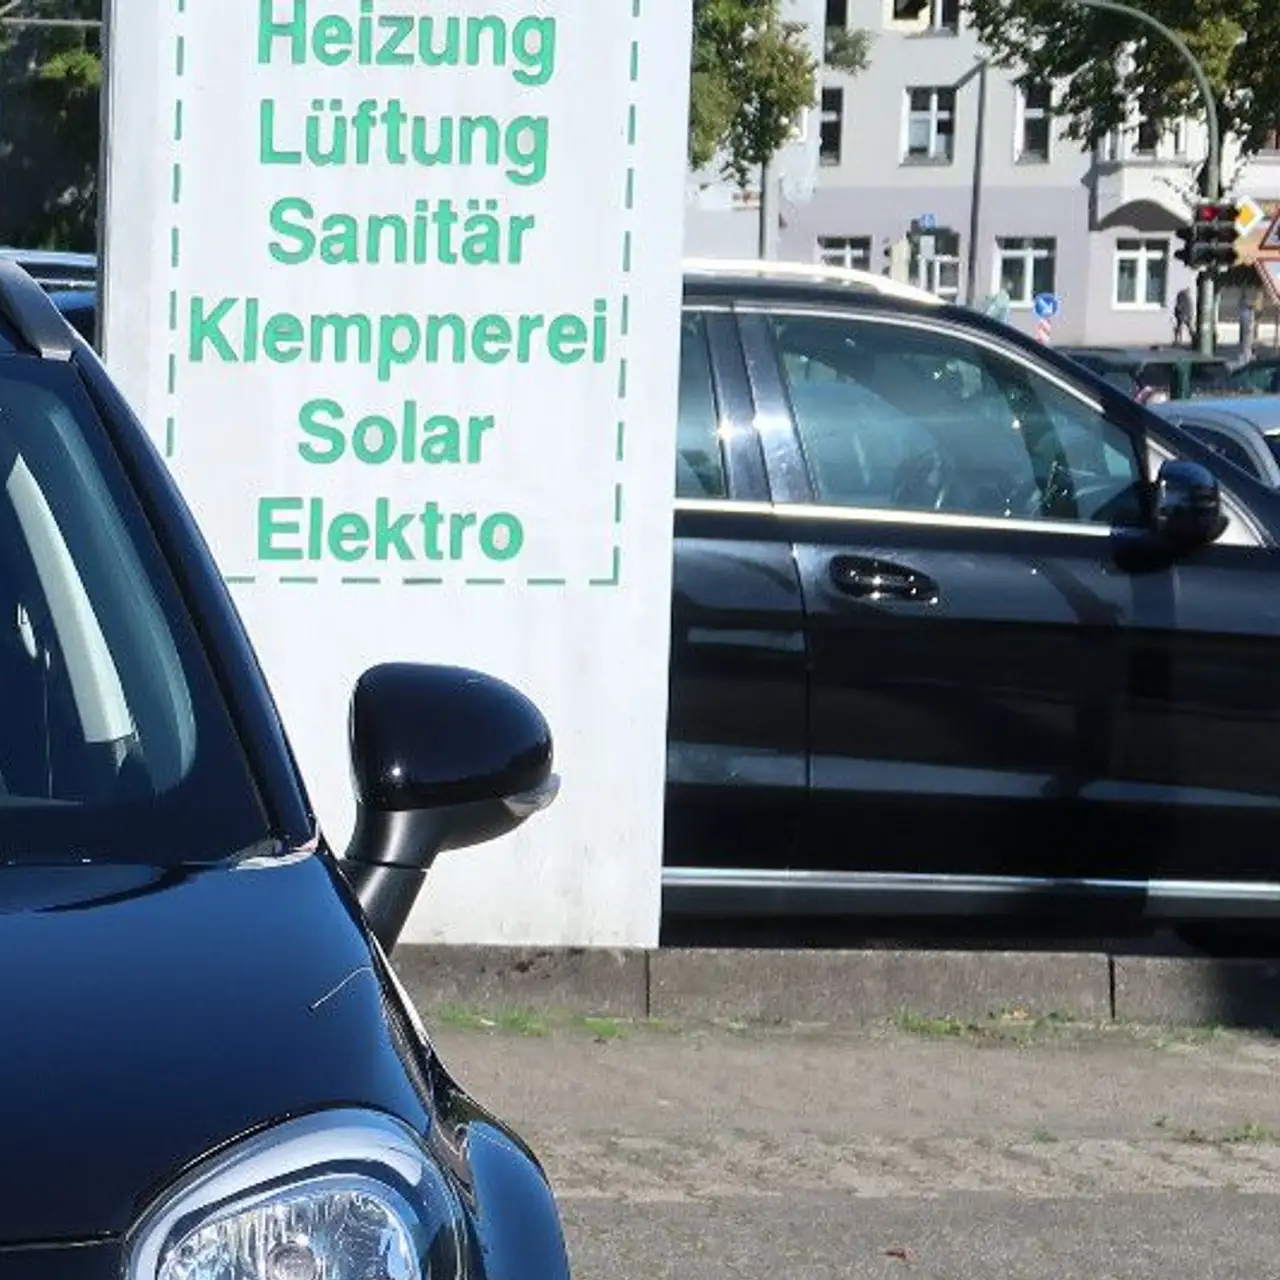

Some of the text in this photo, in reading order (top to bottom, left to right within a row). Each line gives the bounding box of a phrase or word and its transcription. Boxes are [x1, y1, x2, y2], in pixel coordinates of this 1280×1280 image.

[256, 0, 557, 87] Heizung
[258, 98, 550, 185] Lüftung
[267, 196, 536, 266] Sanitär
[188, 297, 609, 383] Klempnerei
[298, 397, 495, 464] Solar
[256, 497, 525, 562] Elektro
